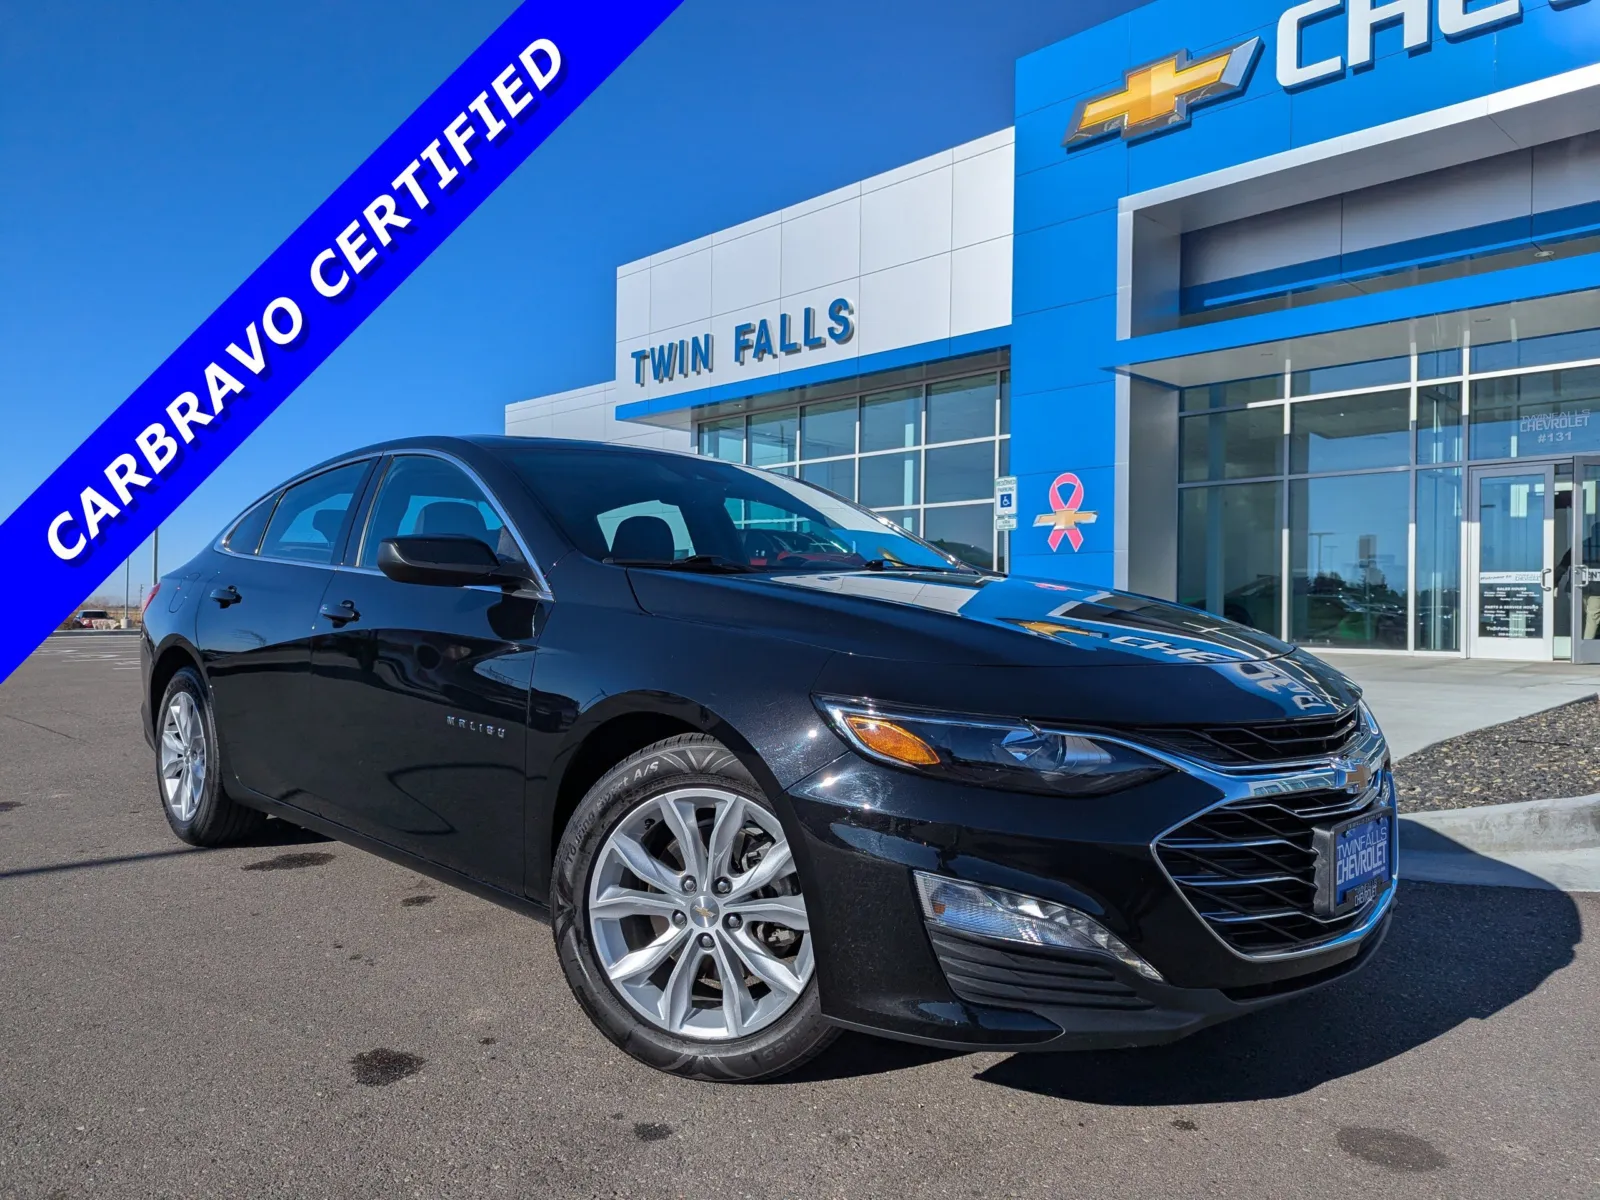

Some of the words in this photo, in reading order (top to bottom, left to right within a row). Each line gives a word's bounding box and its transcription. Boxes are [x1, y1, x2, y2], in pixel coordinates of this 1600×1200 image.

[631, 333, 714, 387] TWIN
[734, 298, 855, 366] FALLS
[1520, 416, 1590, 432] CHEVROLET
[1538, 432, 1572, 443] #131
[634, 761, 659, 782] A/S
[1336, 840, 1387, 886] CHEVROLET
